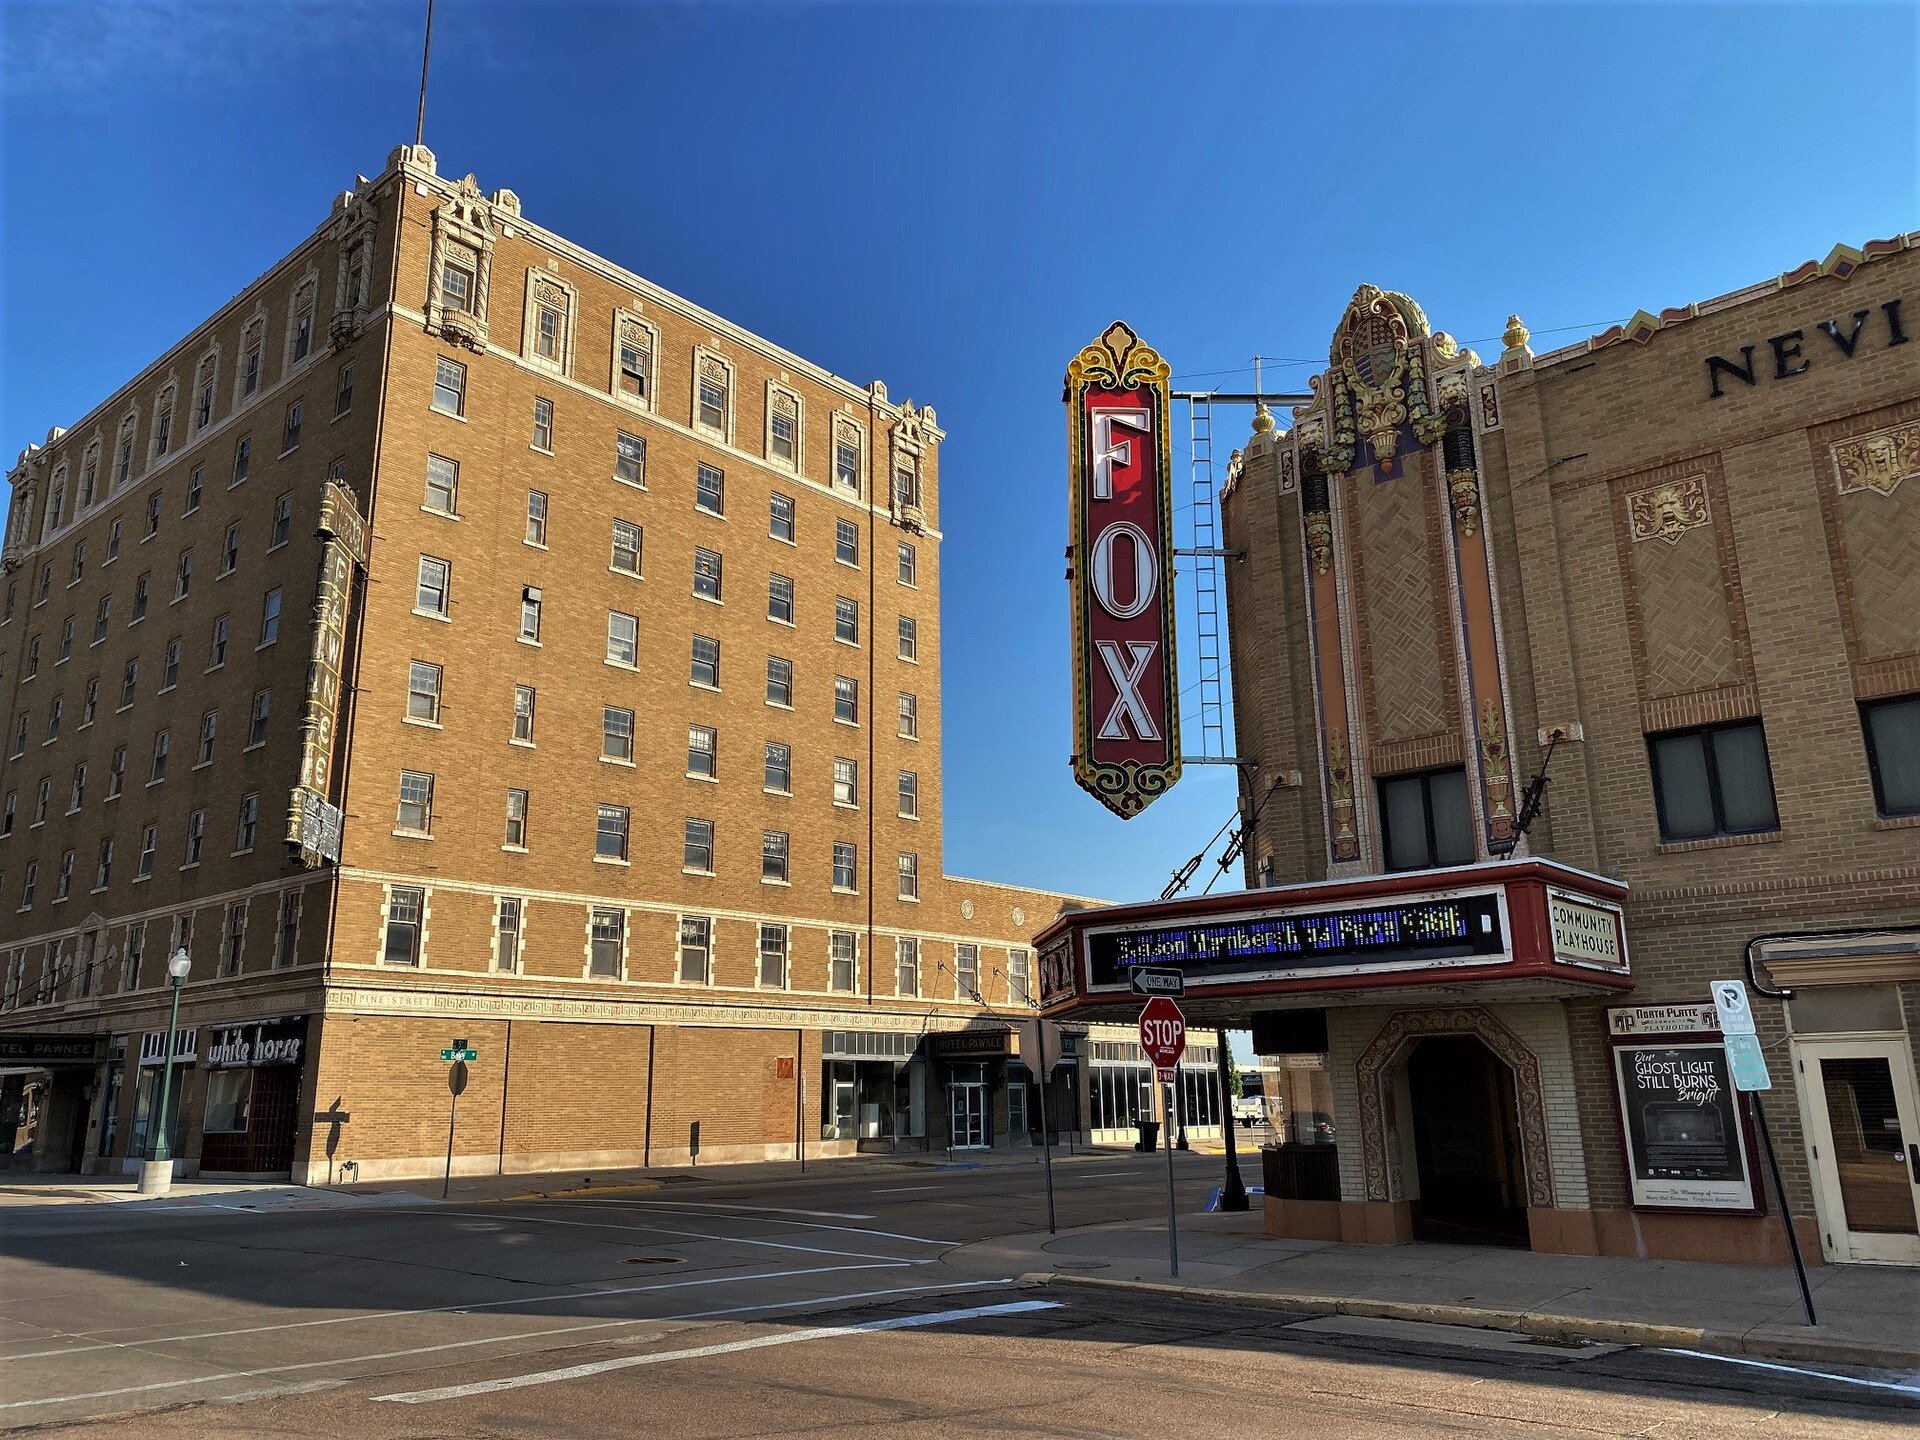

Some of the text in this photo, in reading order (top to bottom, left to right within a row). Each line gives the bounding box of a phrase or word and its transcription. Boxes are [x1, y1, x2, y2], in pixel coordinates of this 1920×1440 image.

[1090, 407, 1162, 741] FOX
[1552, 906, 1612, 934] COMMUNITY
[1556, 929, 1615, 955] PLAYHOUSE
[1147, 976, 1178, 988] ONE WAY
[1143, 1019, 1182, 1046] STOP
[34, 1043, 91, 1054] PAWNEE
[208, 1026, 300, 1062] white horse
[969, 1037, 1002, 1049] PAWNEE
[1634, 1051, 1655, 1062] Our
[1635, 1060, 1714, 1075] GHOST LIGHT
[1158, 1071, 1174, 1082] 3-WAY
[1637, 1074, 1717, 1089] STILL BURNS
[1676, 1086, 1722, 1106] Bright
